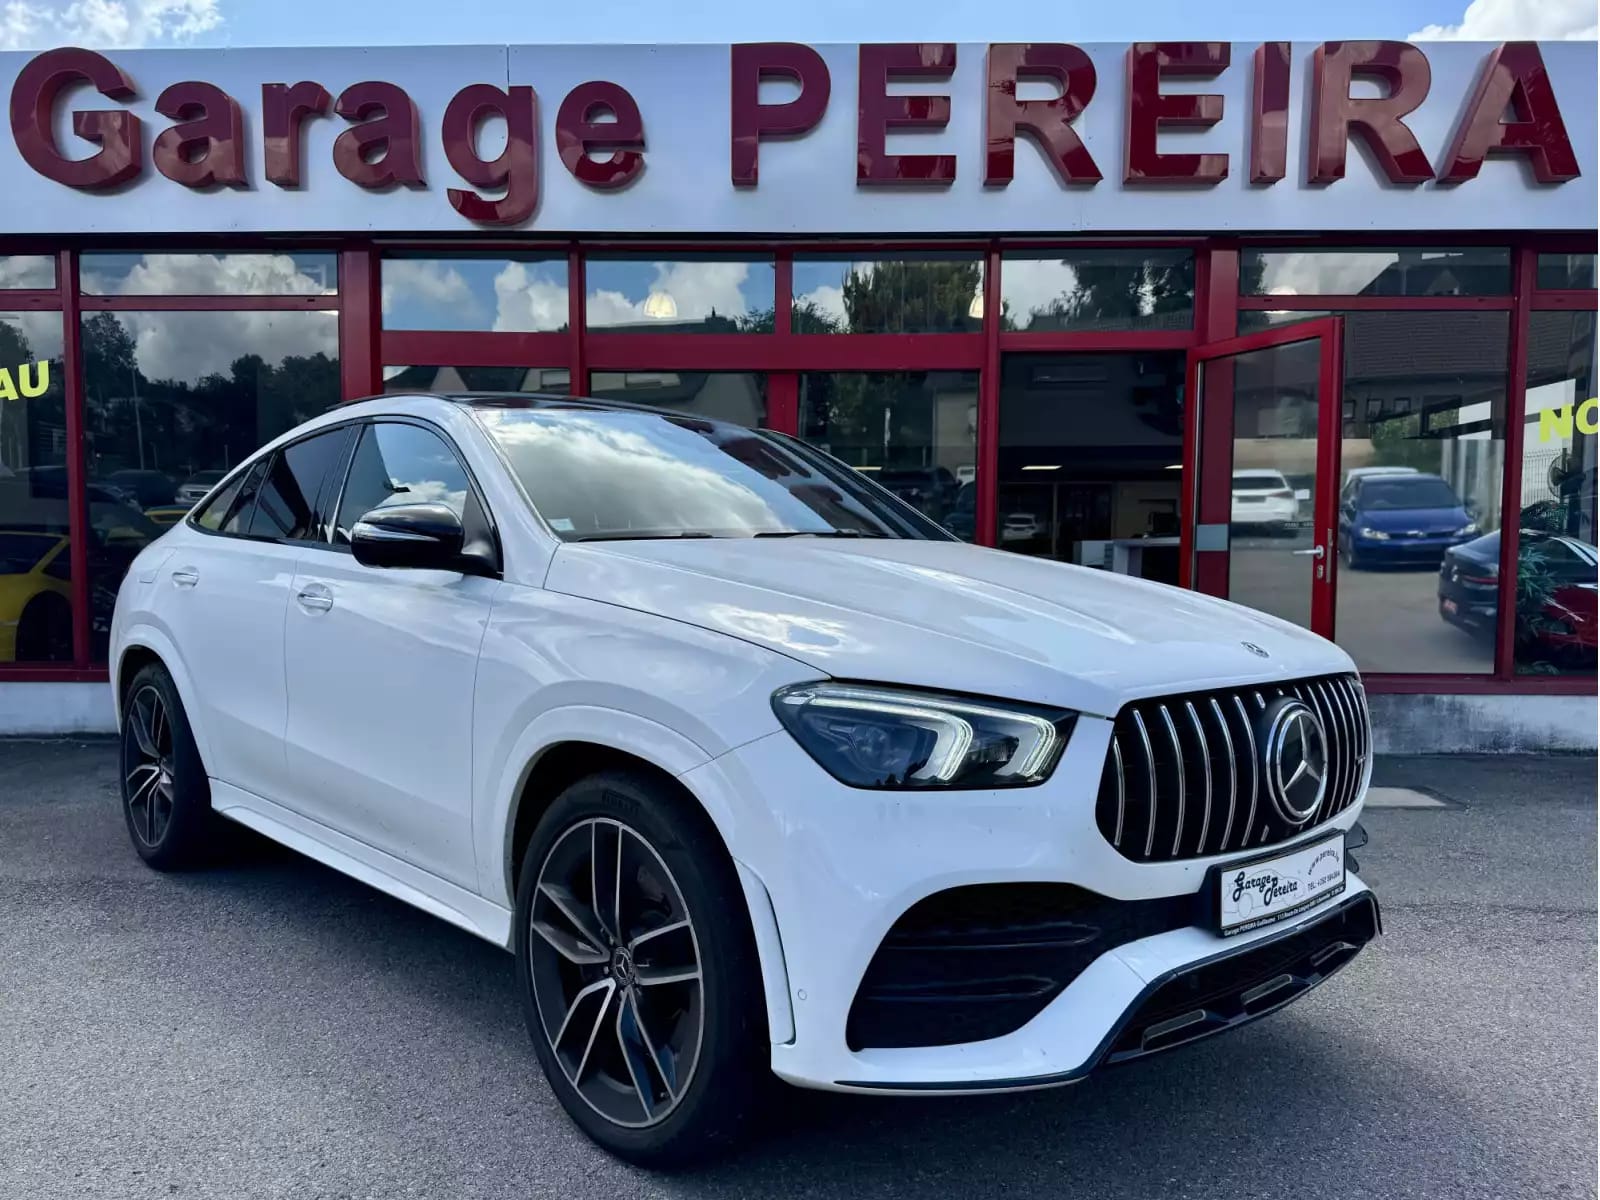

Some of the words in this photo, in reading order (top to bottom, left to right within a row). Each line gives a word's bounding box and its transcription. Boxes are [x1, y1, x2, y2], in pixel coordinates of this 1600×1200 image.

[10, 47, 646, 226] Garage
[731, 41, 1582, 187] PEREIRA
[1233, 871, 1271, 902] Garage
[1264, 876, 1298, 906] Pereira
[1224, 928, 1240, 937] Garage
[1239, 922, 1256, 933] PEREIRA
